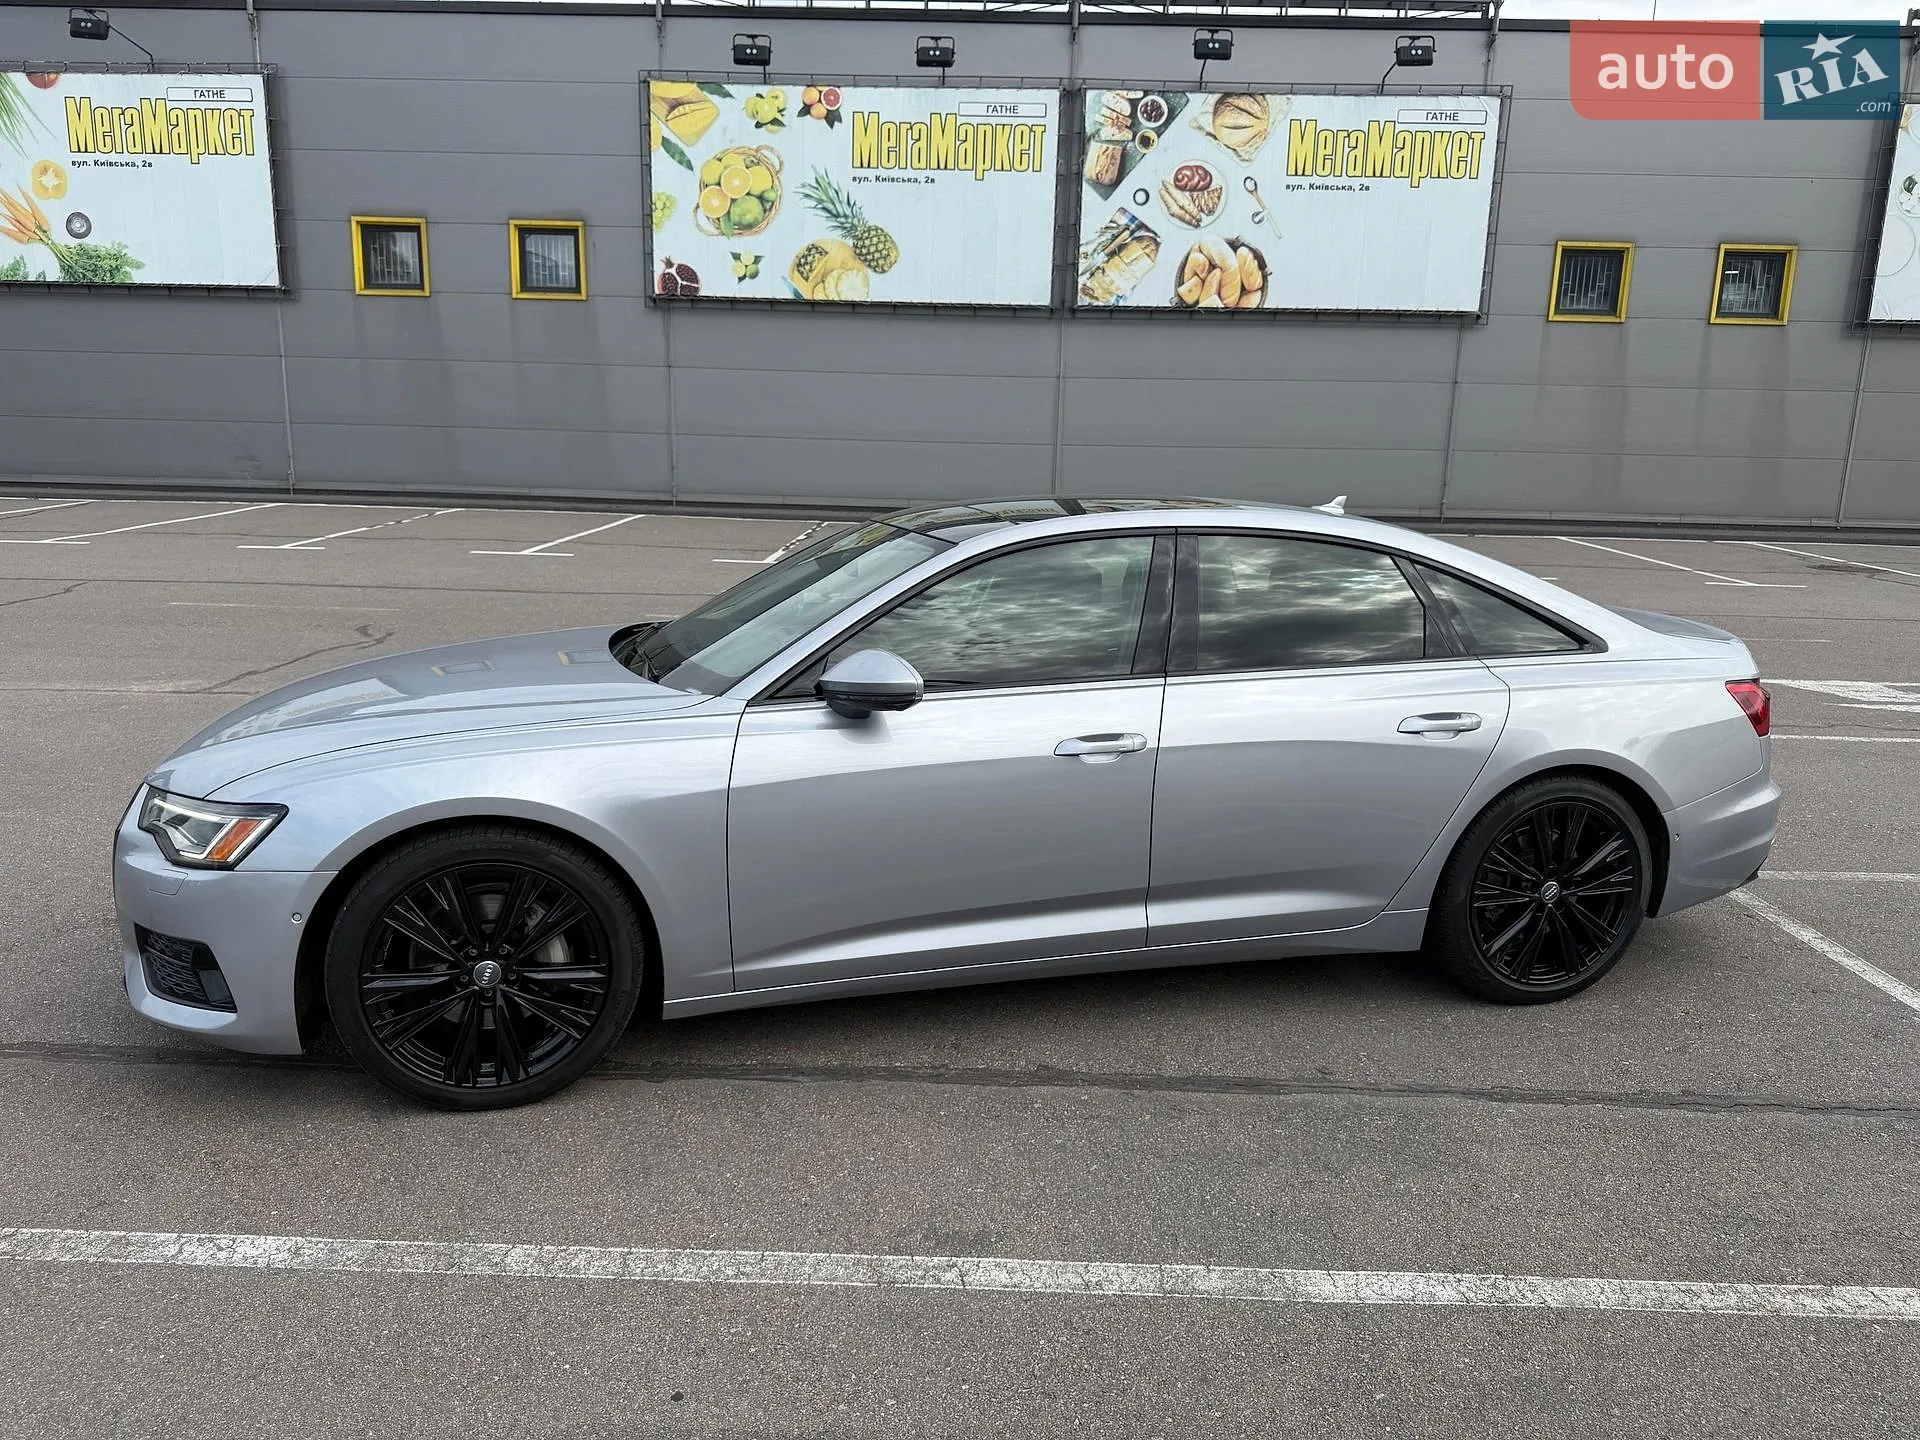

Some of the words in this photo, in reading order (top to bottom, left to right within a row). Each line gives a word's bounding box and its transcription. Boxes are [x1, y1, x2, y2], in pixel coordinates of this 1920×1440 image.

[193, 89, 226, 99] ГАТНЕ
[985, 104, 1019, 114] ГАТНЕ
[1425, 112, 1459, 121] ГАТНЕ
[64, 96, 255, 164] МегаМаркет
[852, 111, 1046, 181] МегаМаркет
[1286, 119, 1486, 188] МегаМаркет
[71, 160, 91, 168] вул.
[93, 159, 139, 169] Київська,
[141, 160, 153, 168] 2в
[852, 176, 872, 184] вул.
[875, 175, 921, 185] Київська,
[924, 176, 935, 184] 2в
[1285, 184, 1306, 192] вул.
[1308, 182, 1355, 192] Київська,
[1358, 183, 1370, 192] 2в
